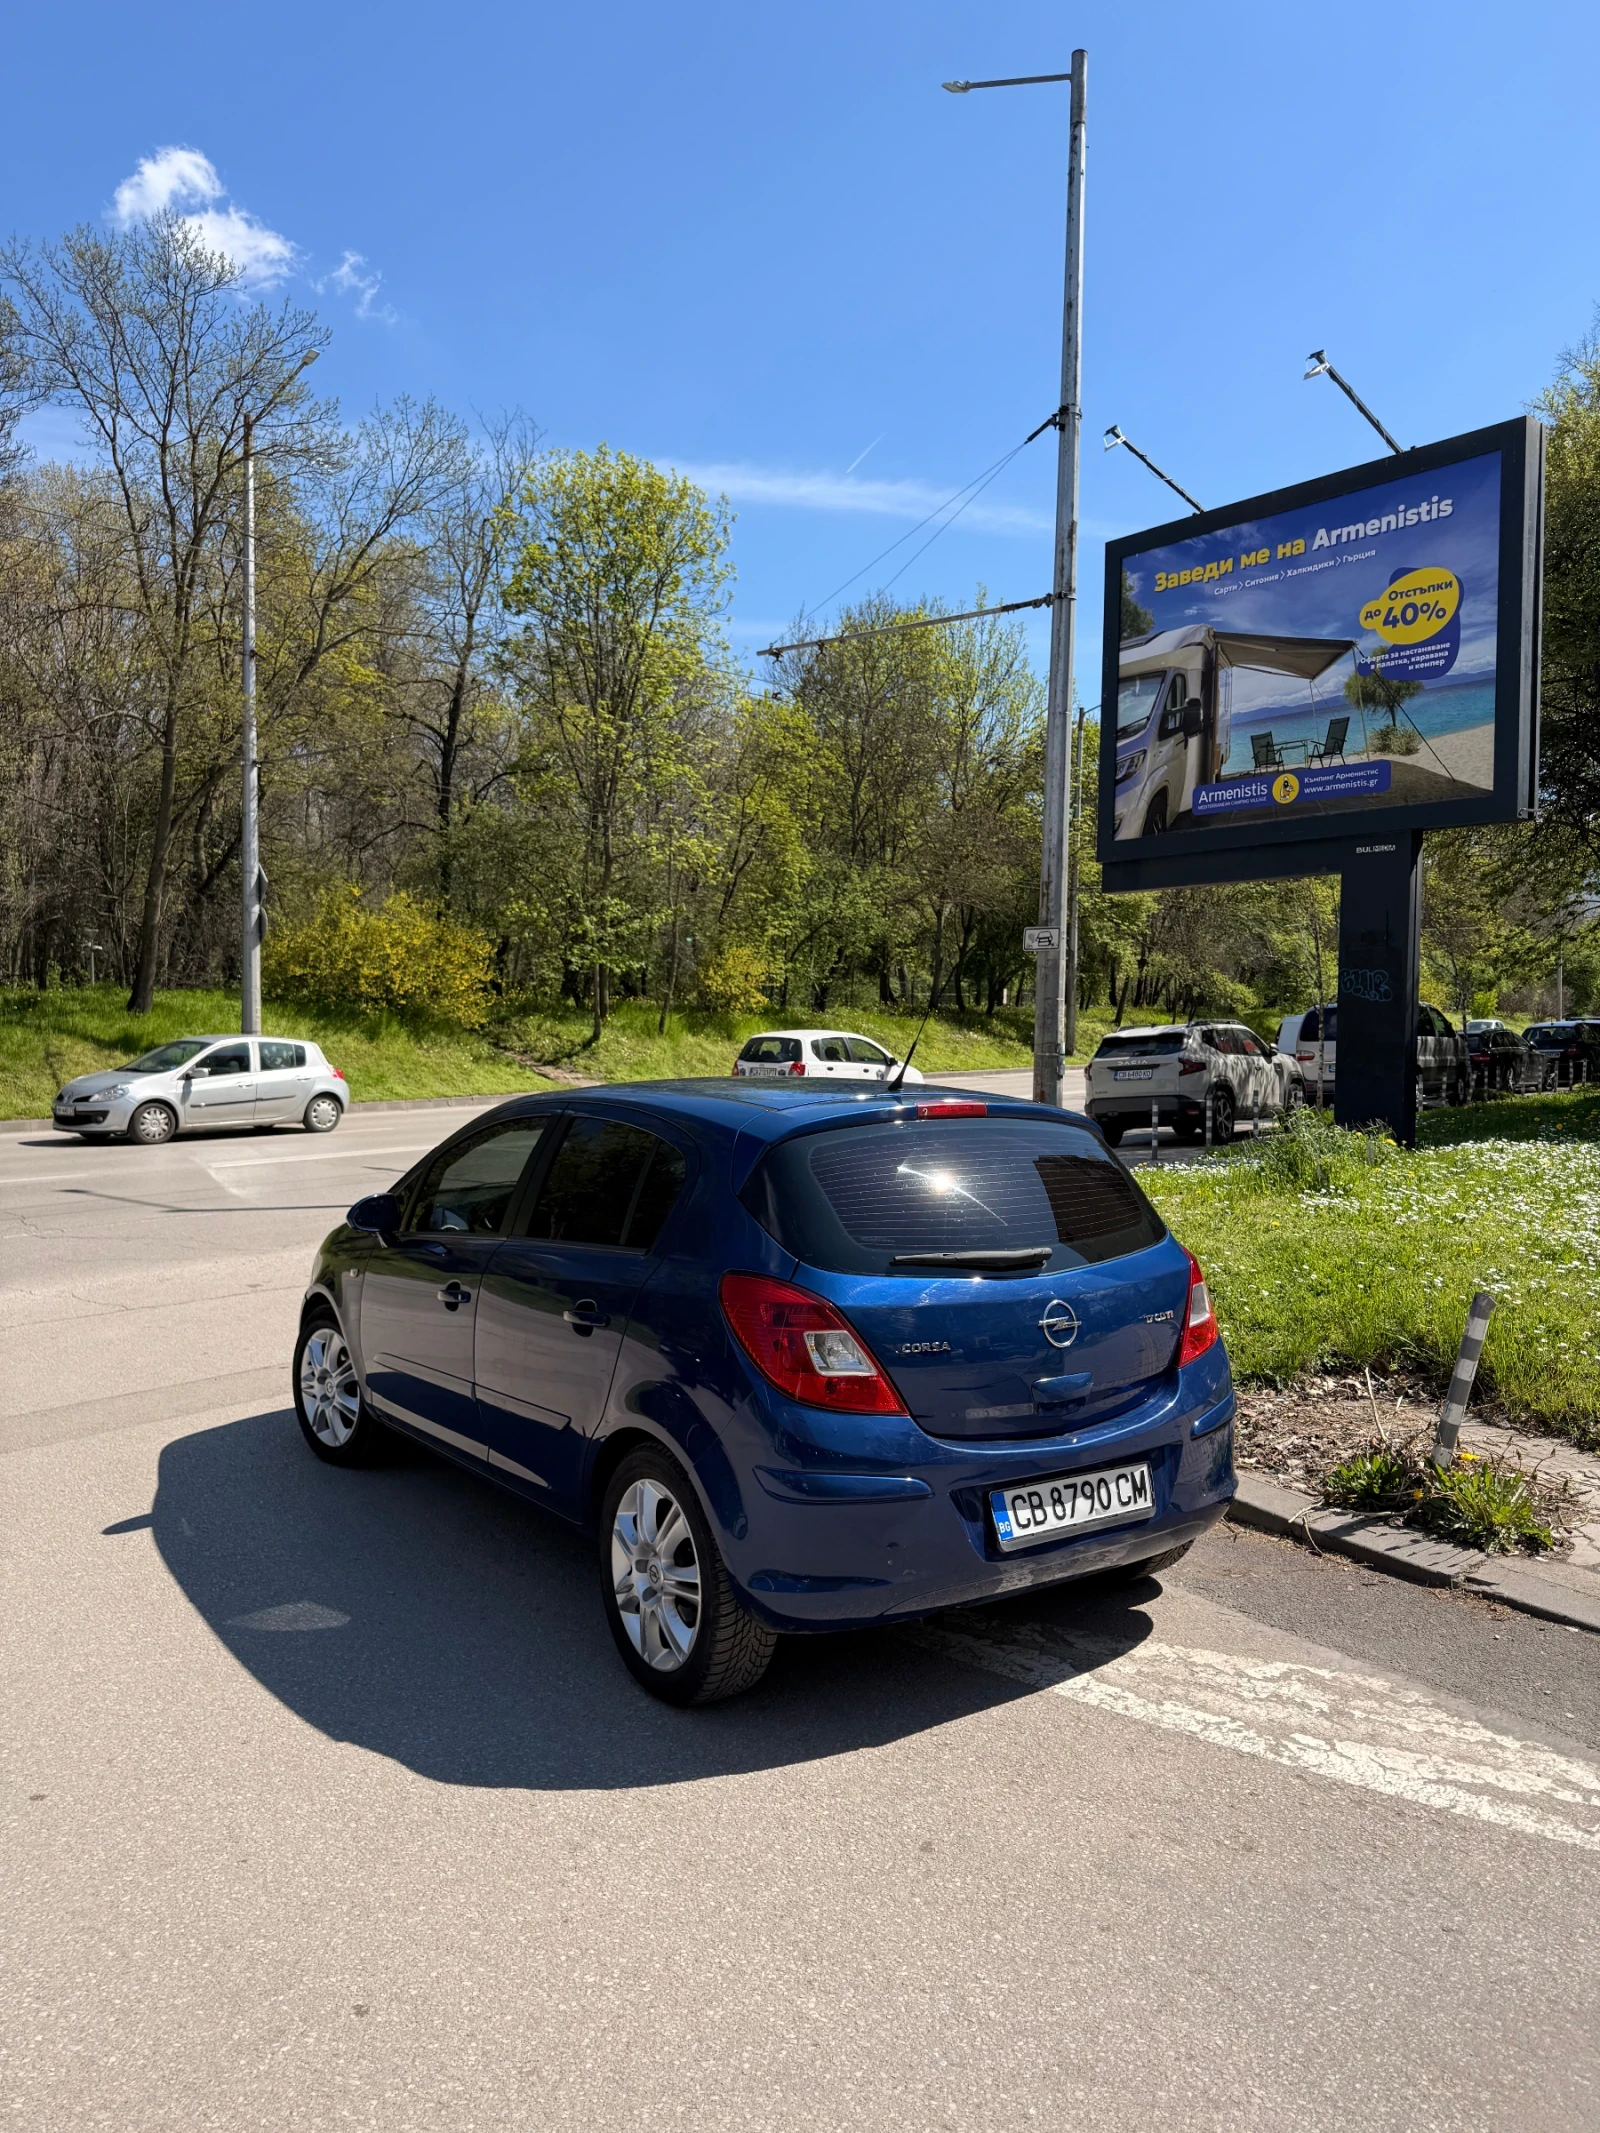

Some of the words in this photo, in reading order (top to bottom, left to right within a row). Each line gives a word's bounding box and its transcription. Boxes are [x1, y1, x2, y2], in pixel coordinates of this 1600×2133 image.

[1154, 557, 1234, 592] Заведи
[1240, 548, 1271, 569] ме
[1277, 538, 1306, 559] на
[1312, 495, 1454, 551] Armenistis
[1214, 584, 1238, 596] Сарти
[1245, 574, 1279, 588] Ситония
[1286, 560, 1335, 578] Халкидики
[1343, 549, 1376, 564] Гърция
[1388, 580, 1453, 601] Отстъпки
[1364, 609, 1382, 621] до
[1383, 600, 1447, 629] 40%
[1360, 654, 1389, 665] Оферта
[1390, 651, 1399, 659] за
[1400, 642, 1451, 657] настаняване
[1376, 658, 1410, 669] палатка,
[1411, 650, 1449, 663] каравана
[1415, 659, 1446, 670] кемпер
[1304, 774, 1335, 784] Къмпинг
[1335, 768, 1379, 780] Арменистис
[1304, 778, 1379, 794] www.armenistis.gr
[1198, 782, 1268, 804] Armenistis
[901, 1341, 951, 1353] CORSA
[999, 1521, 1011, 1534] BG
